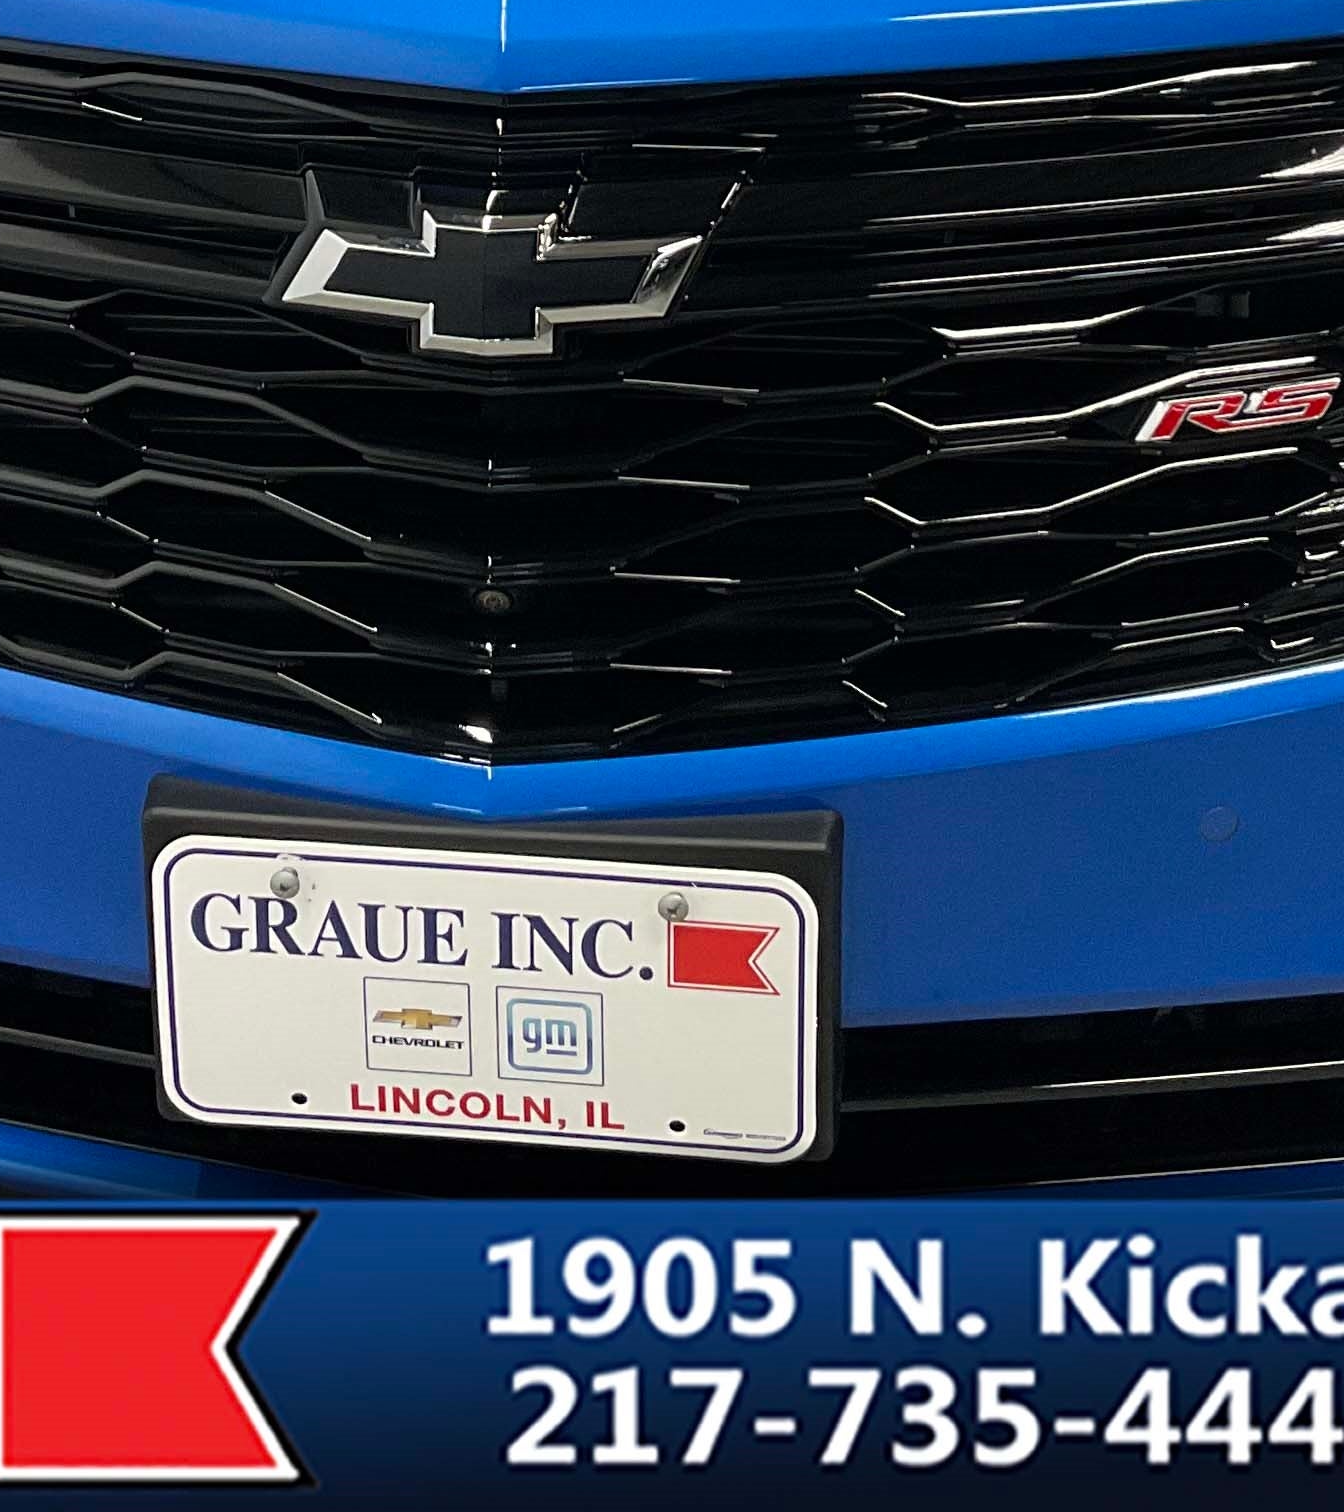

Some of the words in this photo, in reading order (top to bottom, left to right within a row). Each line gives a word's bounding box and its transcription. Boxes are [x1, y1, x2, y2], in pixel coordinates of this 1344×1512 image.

[1135, 377, 1342, 441] RS
[190, 893, 468, 967] GRAUE
[491, 912, 654, 981] INC.
[371, 1035, 464, 1050] CHEVROLET
[522, 1017, 577, 1055] gm
[350, 1083, 567, 1130] LINCOLN,
[586, 1100, 625, 1130] IL
